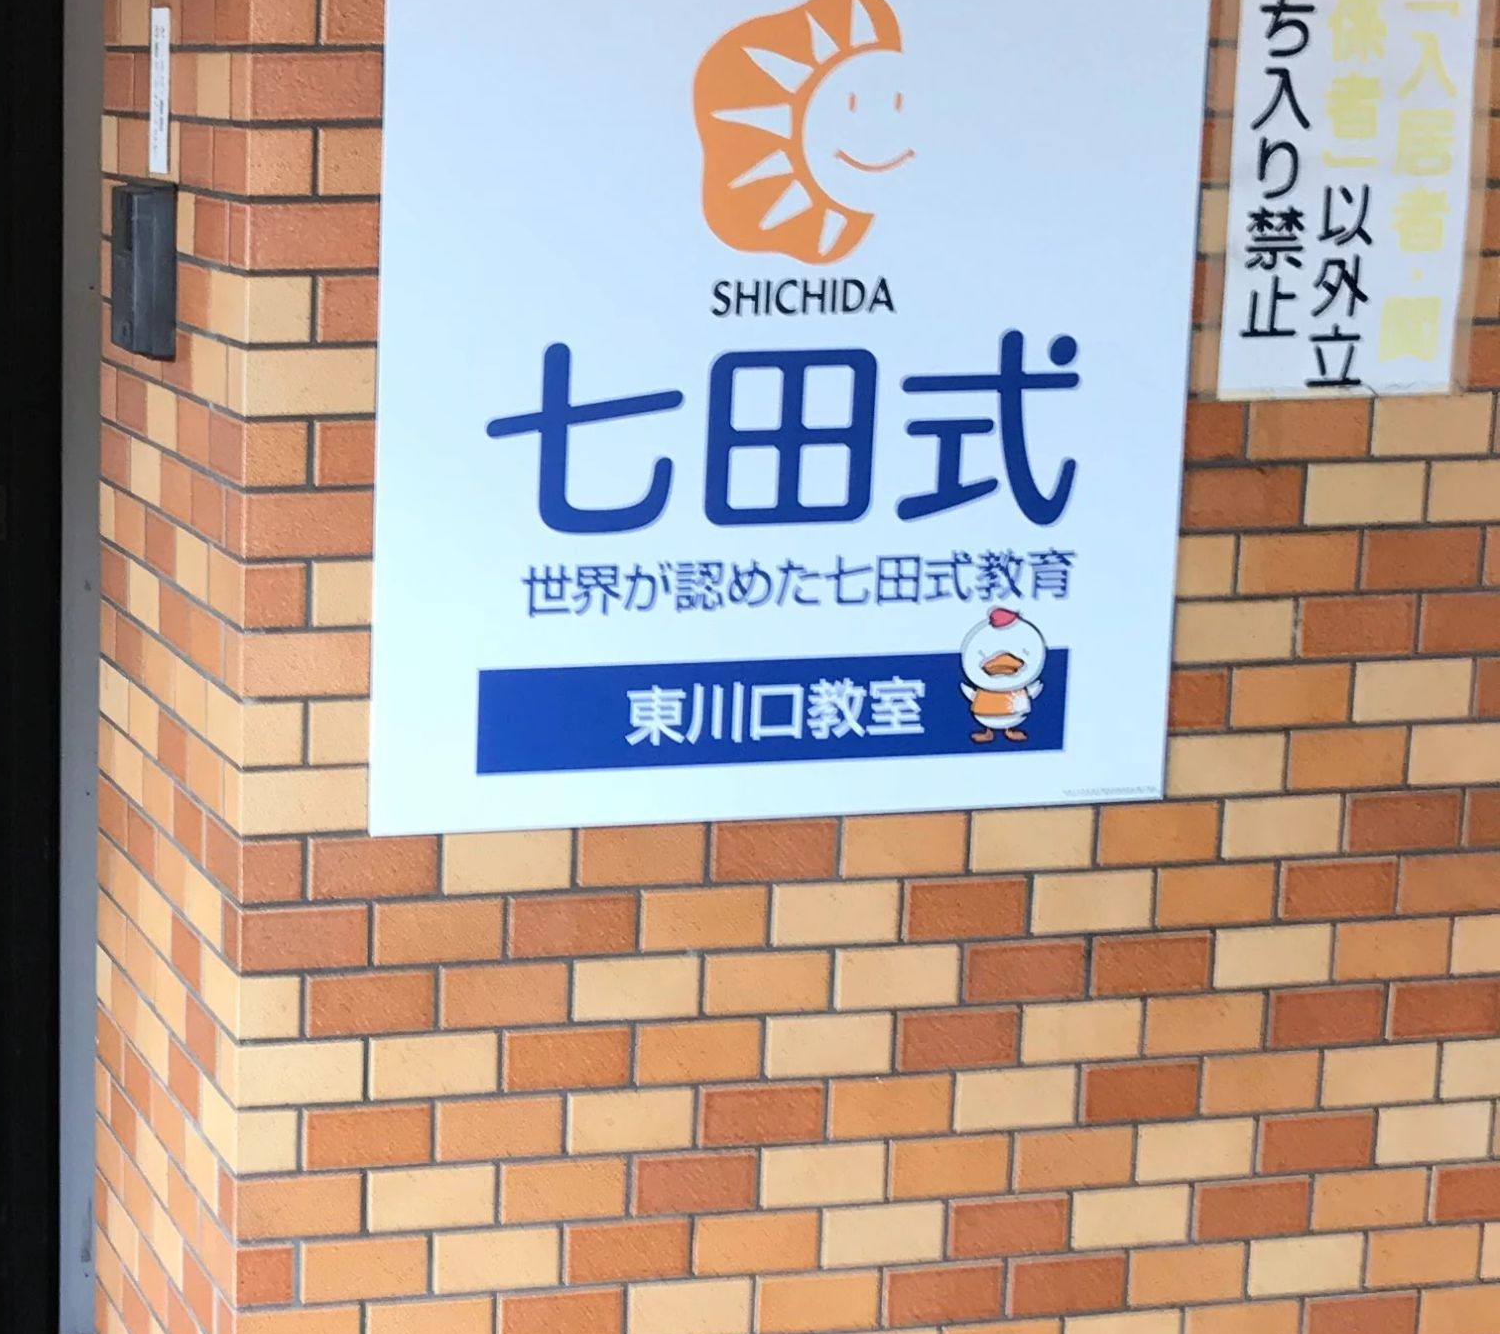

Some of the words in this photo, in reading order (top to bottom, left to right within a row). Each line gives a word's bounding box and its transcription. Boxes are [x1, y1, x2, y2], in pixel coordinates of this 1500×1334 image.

[710, 275, 896, 317] SHICHIDA
[485, 329, 1081, 535] 七田式
[522, 547, 1076, 617] 世界が認めた七田式教育
[624, 675, 927, 747] 東川口教室
